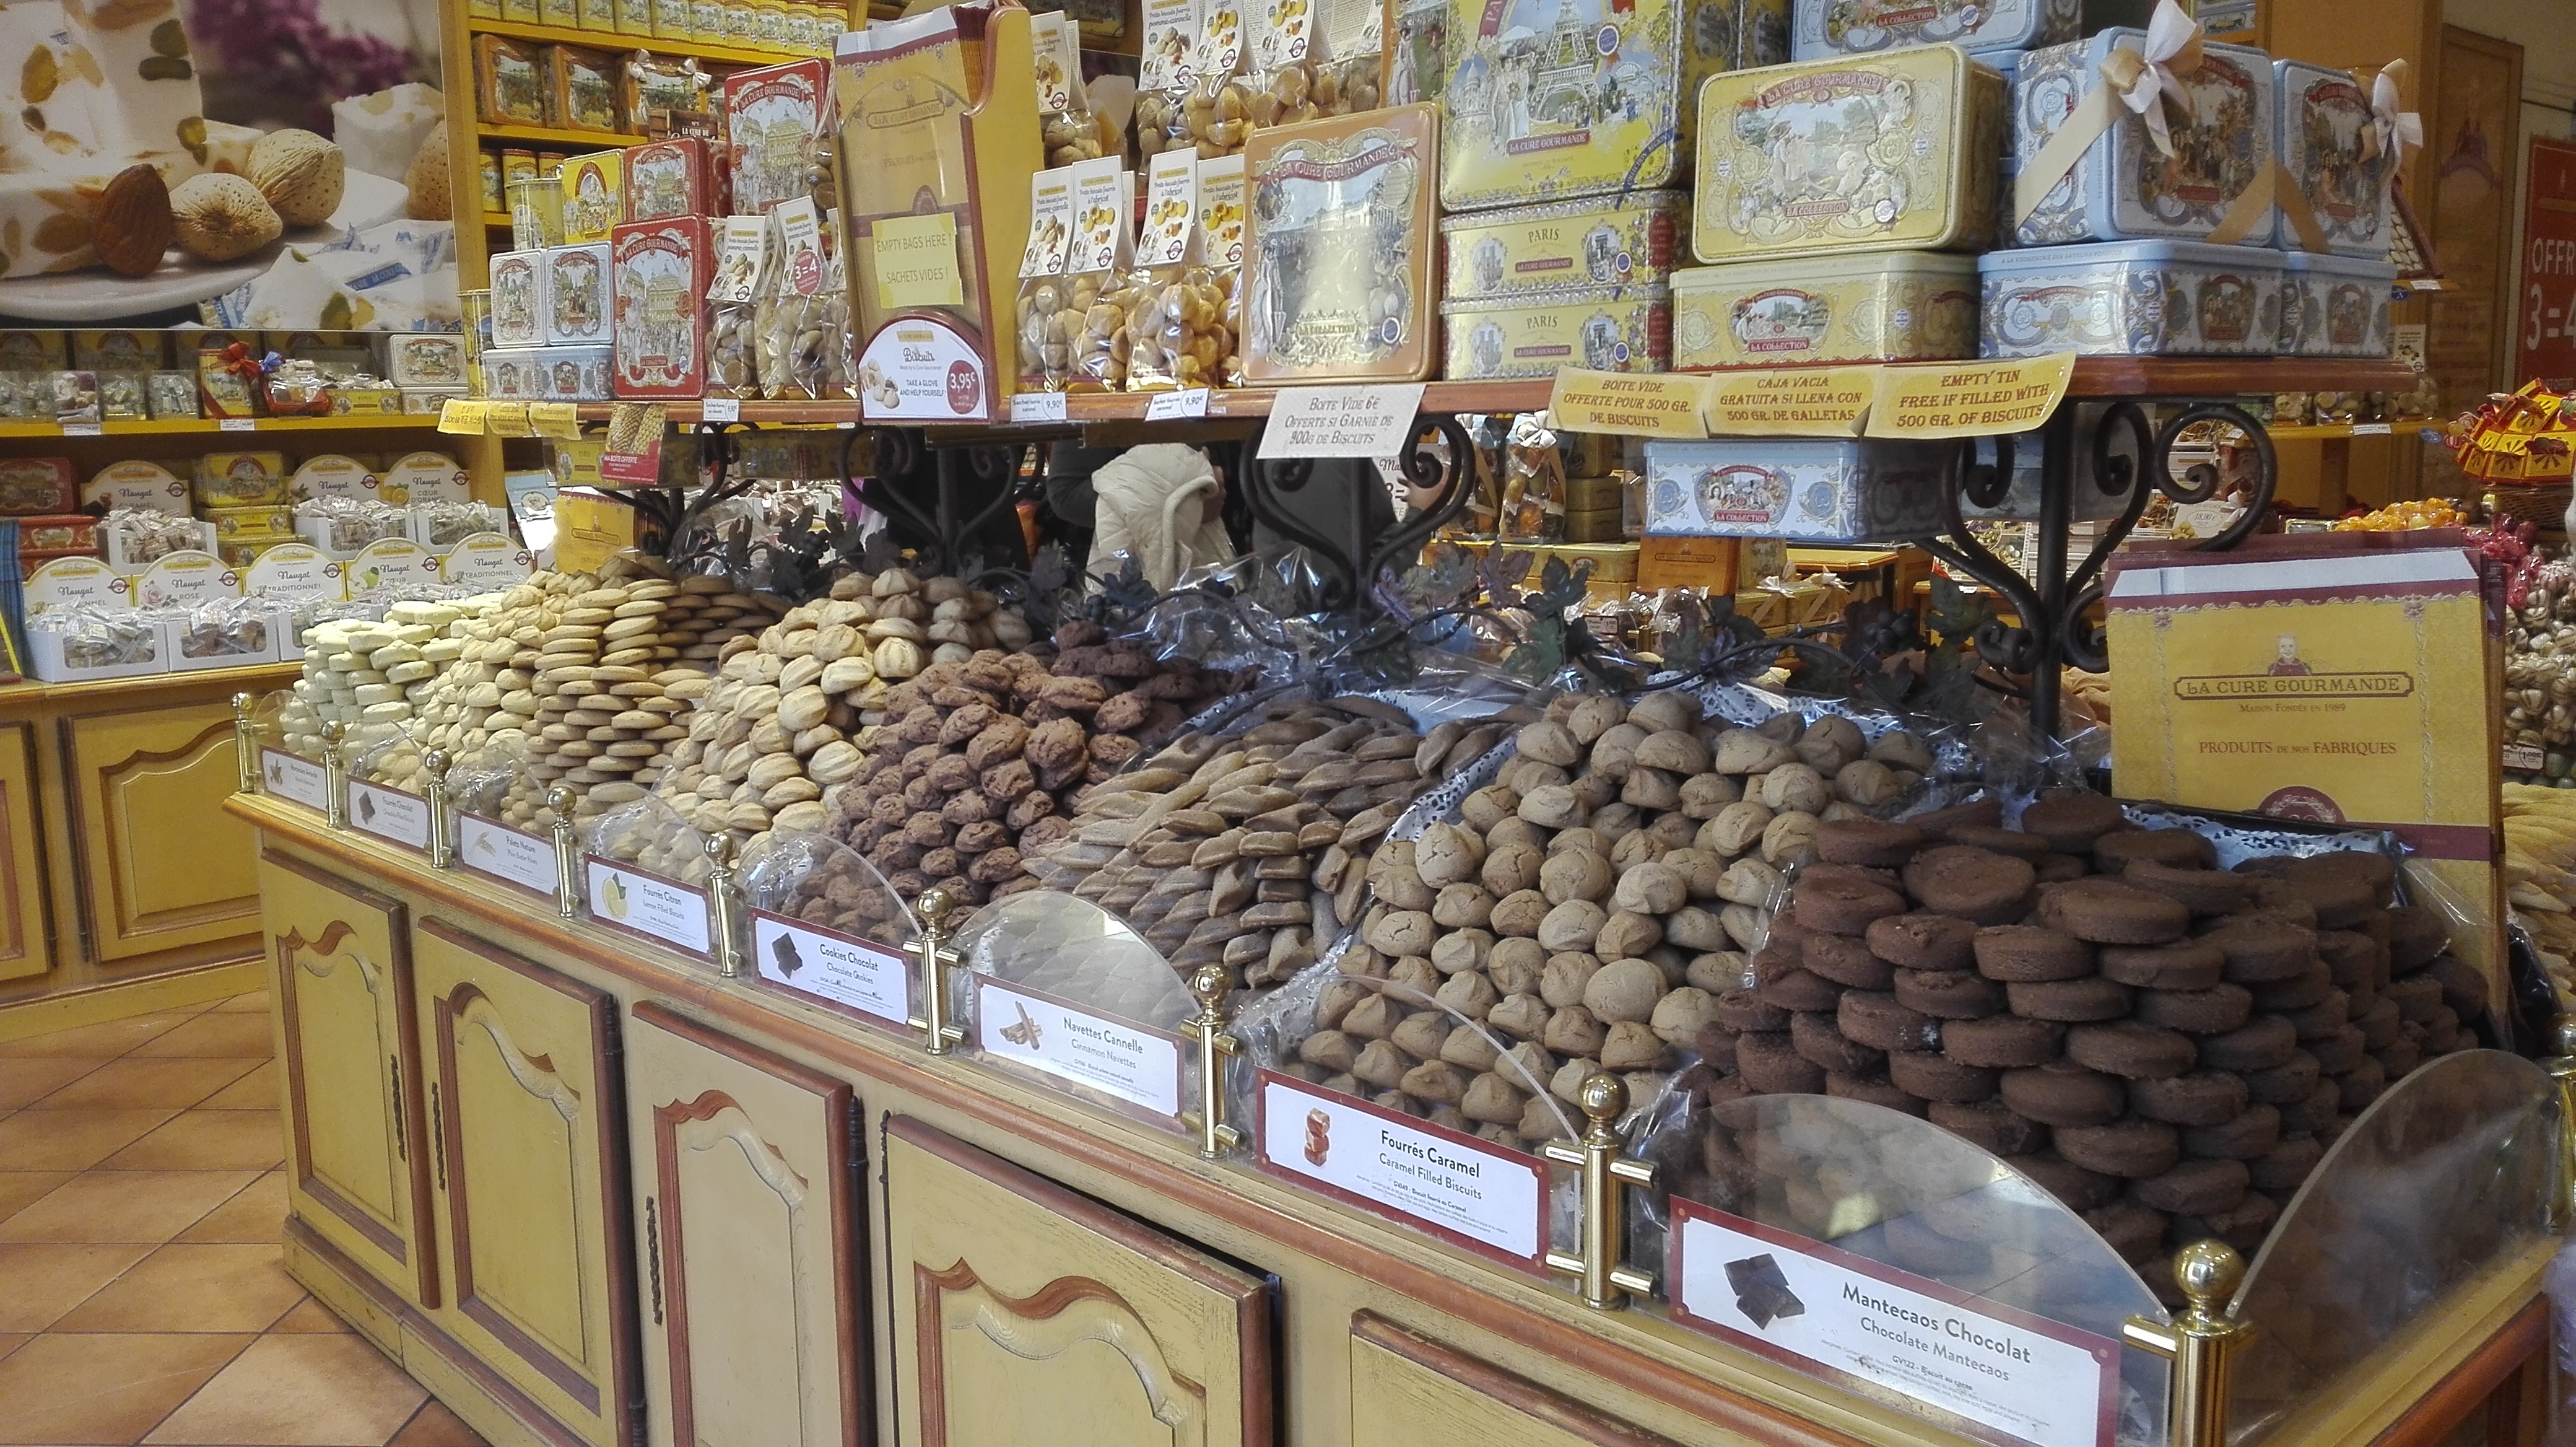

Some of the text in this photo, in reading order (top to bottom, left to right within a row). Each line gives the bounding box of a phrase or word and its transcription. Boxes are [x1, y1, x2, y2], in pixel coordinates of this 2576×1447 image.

[1889, 11, 1934, 24] COLLECTION
[749, 85, 799, 103] CURE GOURMANDE
[1766, 73, 1881, 102] LA CURE GOURMANDE
[874, 116, 889, 125] LA
[1510, 133, 1586, 153] LA CURE GOURMANDE
[1281, 147, 1389, 180] LA CURE GOURMANDE
[1786, 202, 1847, 216] LA COLLECTION
[877, 234, 947, 253] EMPTY BAGS HERE
[1528, 228, 1560, 243] PARIS
[632, 238, 678, 254] CURE GOURMANDE
[794, 258, 817, 280] 3=4
[1524, 260, 1570, 270] CURE GOURMANDE
[886, 268, 944, 284] SACHETS VIDES
[1526, 315, 1558, 330] PARIS
[1764, 341, 1808, 351] COLLECTION
[903, 347, 936, 362] Biscuits
[906, 379, 938, 387] TAKE GLOVE
[1601, 380, 1666, 393] BOITE VIDE
[1756, 377, 1829, 389] CAJA VACIA
[1941, 370, 2021, 387] EMPTY TIN
[1308, 395, 1381, 411] BOITE VIDE 6€
[1563, 393, 1691, 413] OFFERTE POUR 500 GR.
[1720, 392, 1863, 405] GRATUITA SI LLENA CON
[1899, 383, 2050, 408] FREE IF FILLED WITH
[1285, 414, 1393, 429] OFFERTE SI GARNIE DE
[1590, 411, 1660, 427] DE BISCUITS
[1727, 409, 1855, 421] 500 GR. DE GALLETAS
[1897, 404, 2044, 427] 500 GR. OF BISCUITS
[1315, 435, 1329, 445] DE
[1331, 431, 1375, 445] BISCUITS
[318, 481, 349, 490] Nougat
[412, 476, 441, 486] Nougat
[118, 487, 154, 497] Nougat
[1726, 513, 1767, 521] COLLECTION
[380, 564, 410, 574] Nougat
[474, 557, 503, 568] Nougat
[172, 579, 206, 588] Nougat
[277, 570, 311, 581] Nougat
[58, 587, 94, 597] Nougat
[2187, 678, 2400, 695] LA CURE GOURMANDE
[2240, 704, 2273, 712] MAISON
[2324, 703, 2346, 712] 1989
[2200, 741, 2397, 756] PRODUITS DE NOS FABRIQUES
[506, 836, 536, 853] Palets Nature
[643, 884, 682, 906] Fourrés Citron
[643, 899, 684, 920] Lemon Filled Biscuits
[819, 943, 879, 972] Cookies Chocolat
[827, 962, 874, 984] Chocolate Cookies
[1063, 1016, 1143, 1054] Navettes Cannelle
[1071, 1038, 1136, 1069] Cinnamon Navettes
[1381, 1129, 1480, 1178] Fourrés Caramel
[1379, 1153, 1483, 1200] Caramel Filled Biscuits
[1412, 1187, 1427, 1199] Biscuit
[1427, 1193, 1441, 1204] fourré
[1447, 1200, 1467, 1212] Caramel
[1842, 1281, 2032, 1364] Mantecaos Chocolat
[1860, 1316, 1929, 1352] Chocolate
[1932, 1341, 2010, 1383] Mantecaos
[1892, 1355, 1915, 1369] GV122
[1921, 1366, 1943, 1380] Biscuit
